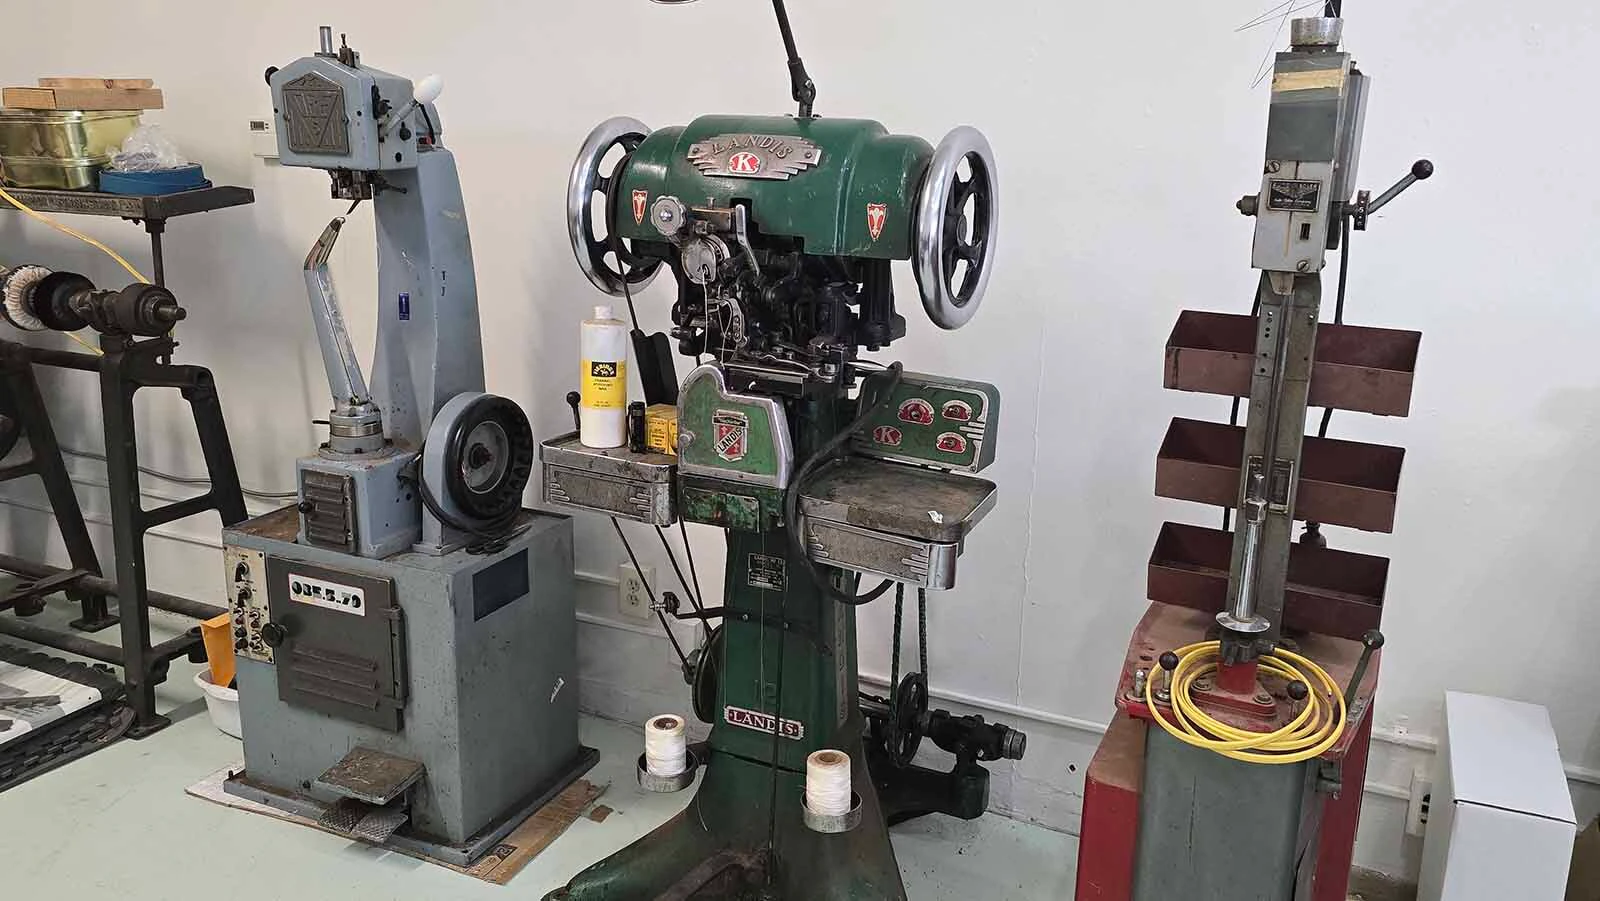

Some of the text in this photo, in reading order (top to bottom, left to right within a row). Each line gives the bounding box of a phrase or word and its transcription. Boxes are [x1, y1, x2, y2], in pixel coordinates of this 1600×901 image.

[711, 135, 793, 159] LANDIS
[735, 154, 754, 172] K
[717, 427, 744, 452] LANDIS
[880, 427, 897, 446] K
[732, 710, 795, 735] LANDIS
